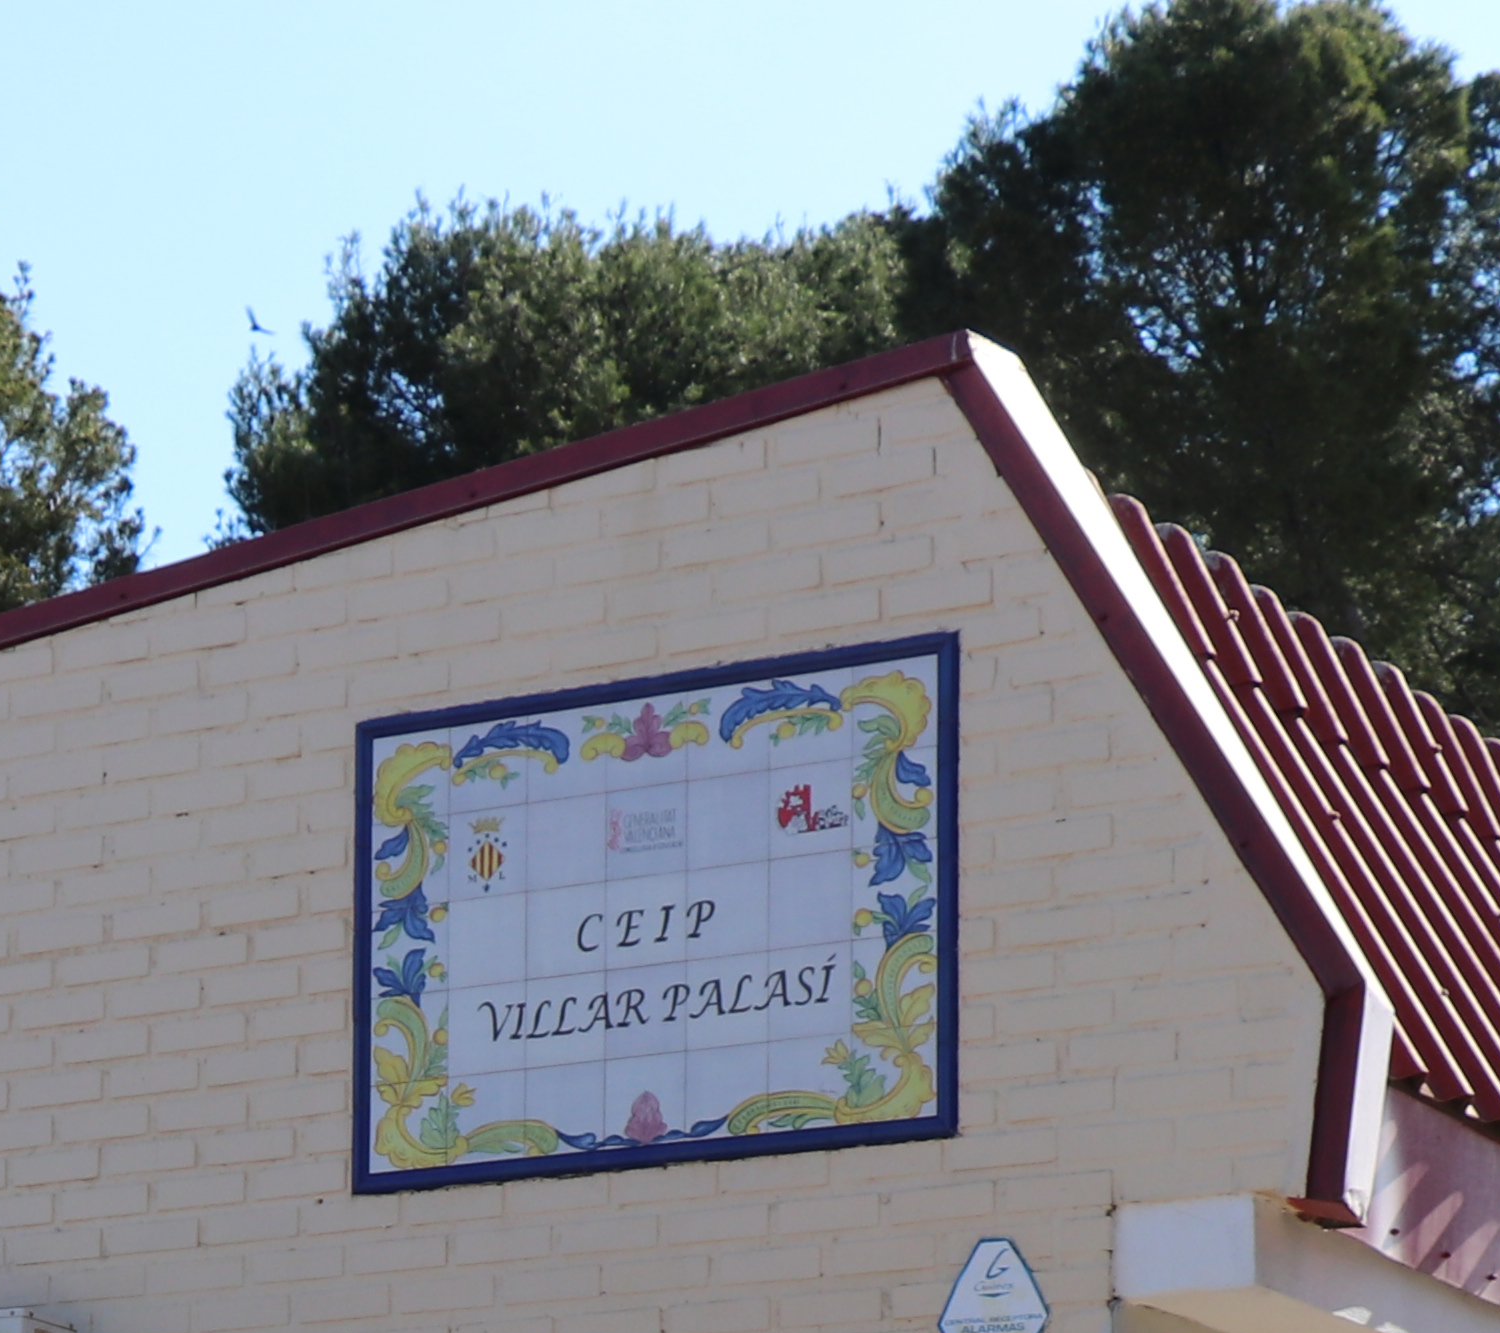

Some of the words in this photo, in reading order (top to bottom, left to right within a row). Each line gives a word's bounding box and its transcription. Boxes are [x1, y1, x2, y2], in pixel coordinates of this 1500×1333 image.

[577, 900, 715, 952] CEIP
[478, 988, 650, 1042] VILLAR
[662, 953, 837, 1023] PALASÍ
[961, 1322, 1025, 1333] ALARMAS
